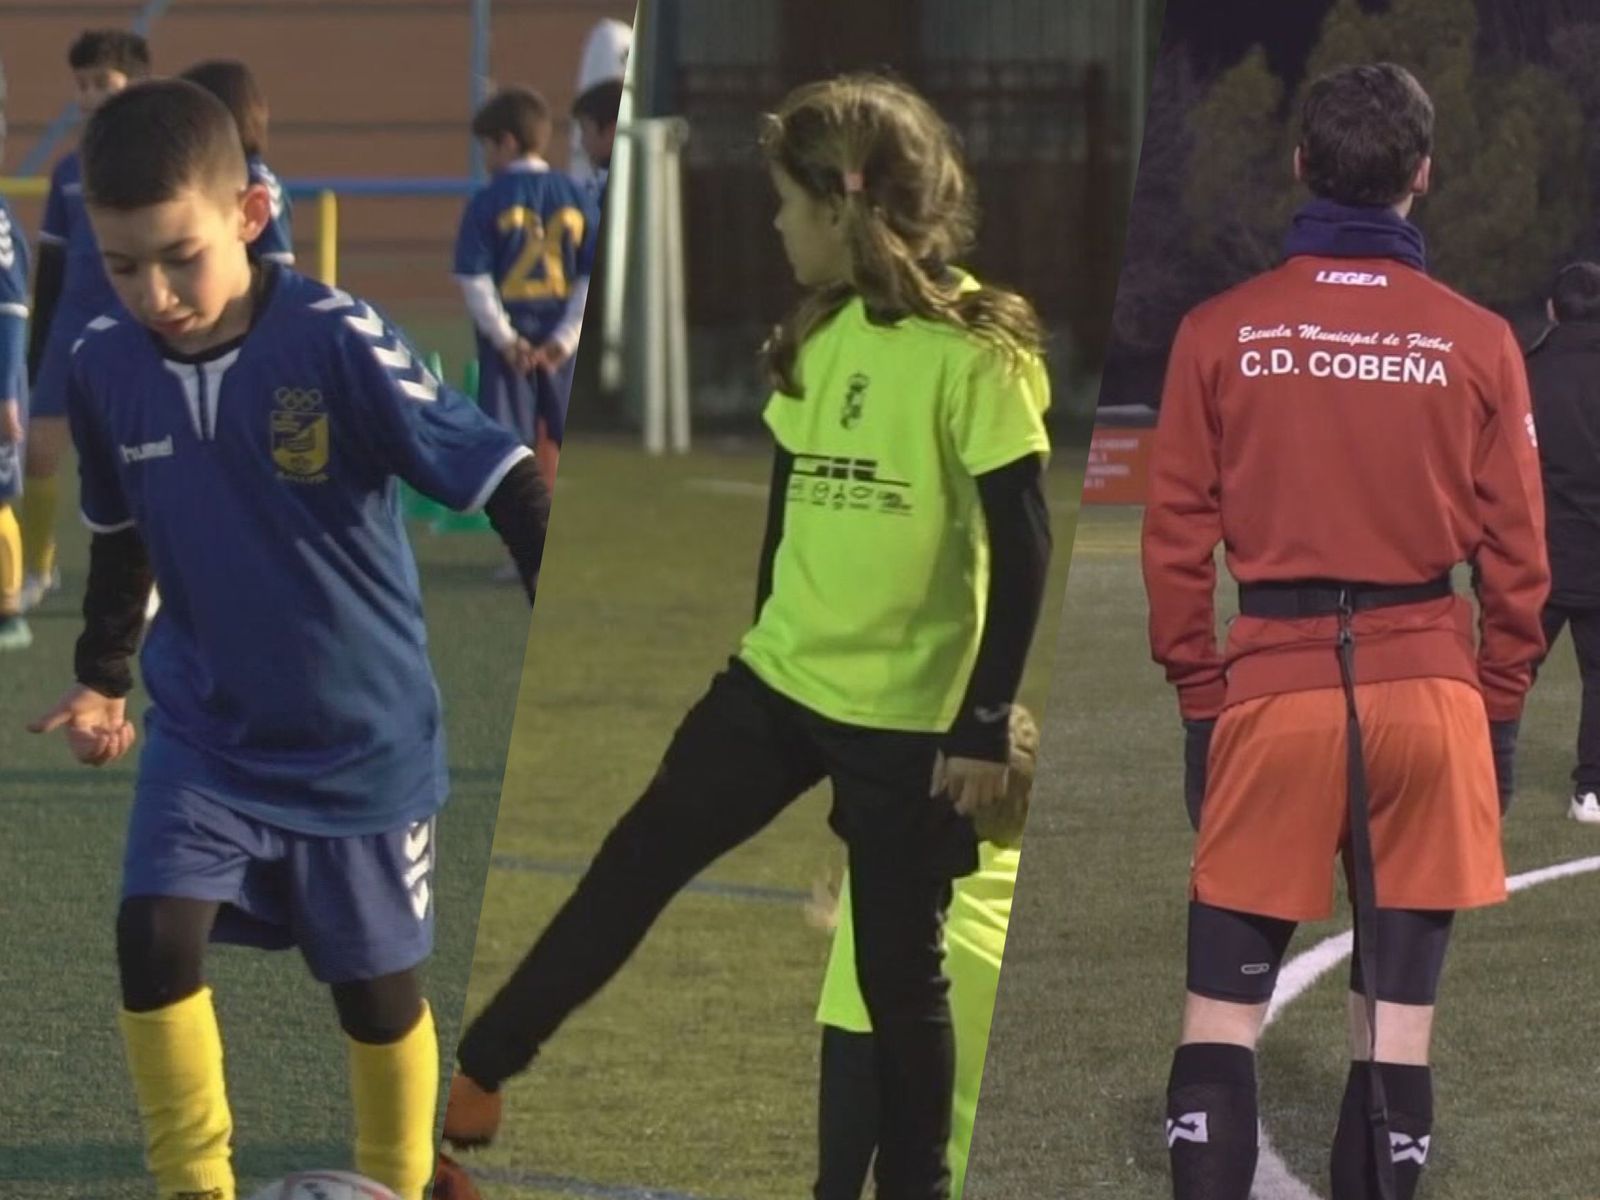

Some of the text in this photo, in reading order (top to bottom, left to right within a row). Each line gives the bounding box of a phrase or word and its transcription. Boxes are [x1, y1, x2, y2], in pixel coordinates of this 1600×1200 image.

[1315, 270, 1388, 287] LEGEA
[1238, 324, 1292, 343] Escuela
[1298, 324, 1378, 346] Municipal
[1382, 333, 1400, 346] de
[1240, 348, 1448, 387] C.D. COBEÑA
